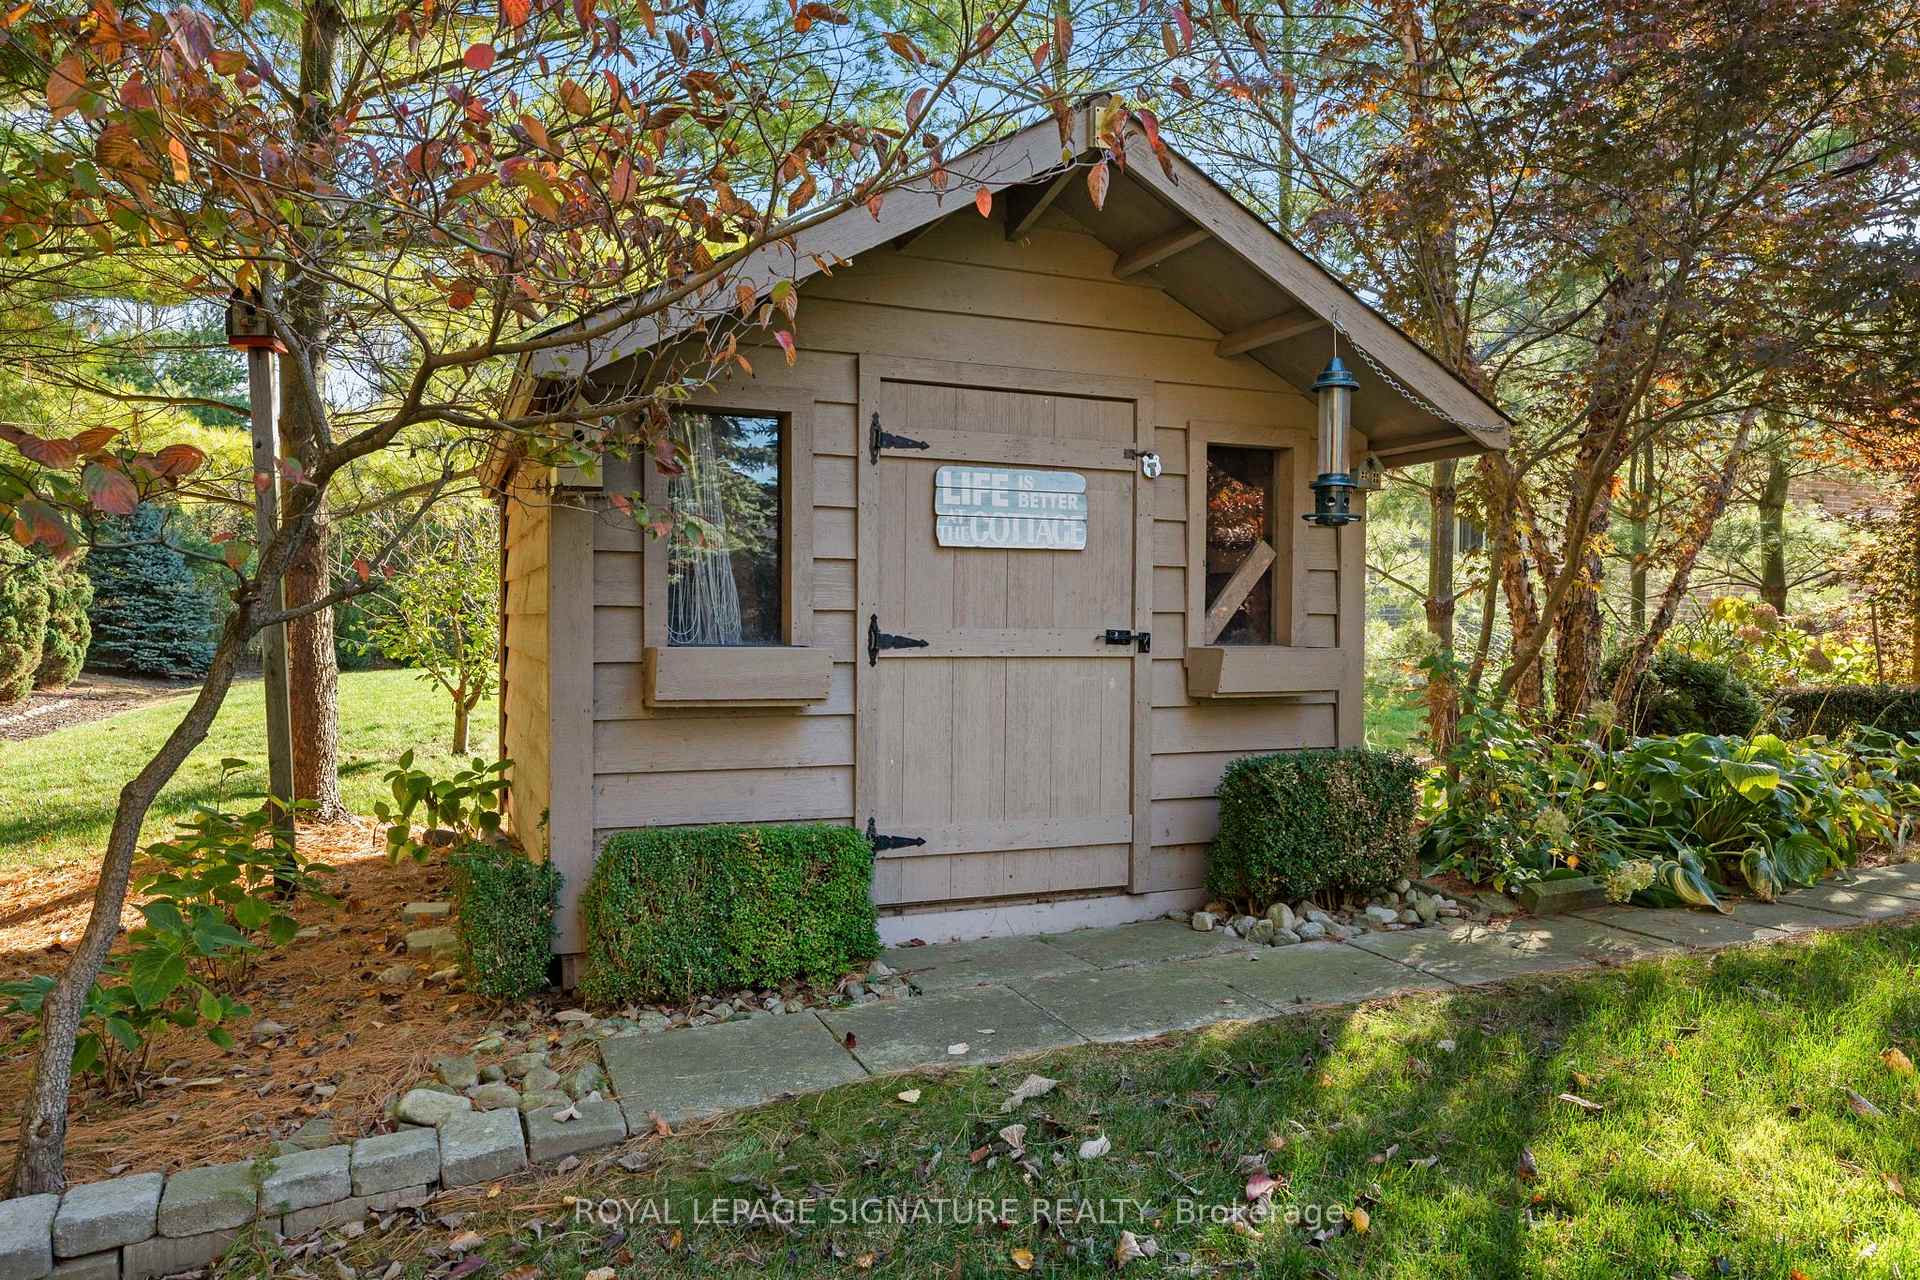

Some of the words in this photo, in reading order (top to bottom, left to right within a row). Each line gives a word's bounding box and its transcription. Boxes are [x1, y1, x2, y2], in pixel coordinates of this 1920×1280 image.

[943, 471, 1009, 507] LIFE
[1019, 475, 1033, 490] IS
[1019, 492, 1078, 509] BETTER
[970, 510, 1084, 544] COTTAGE
